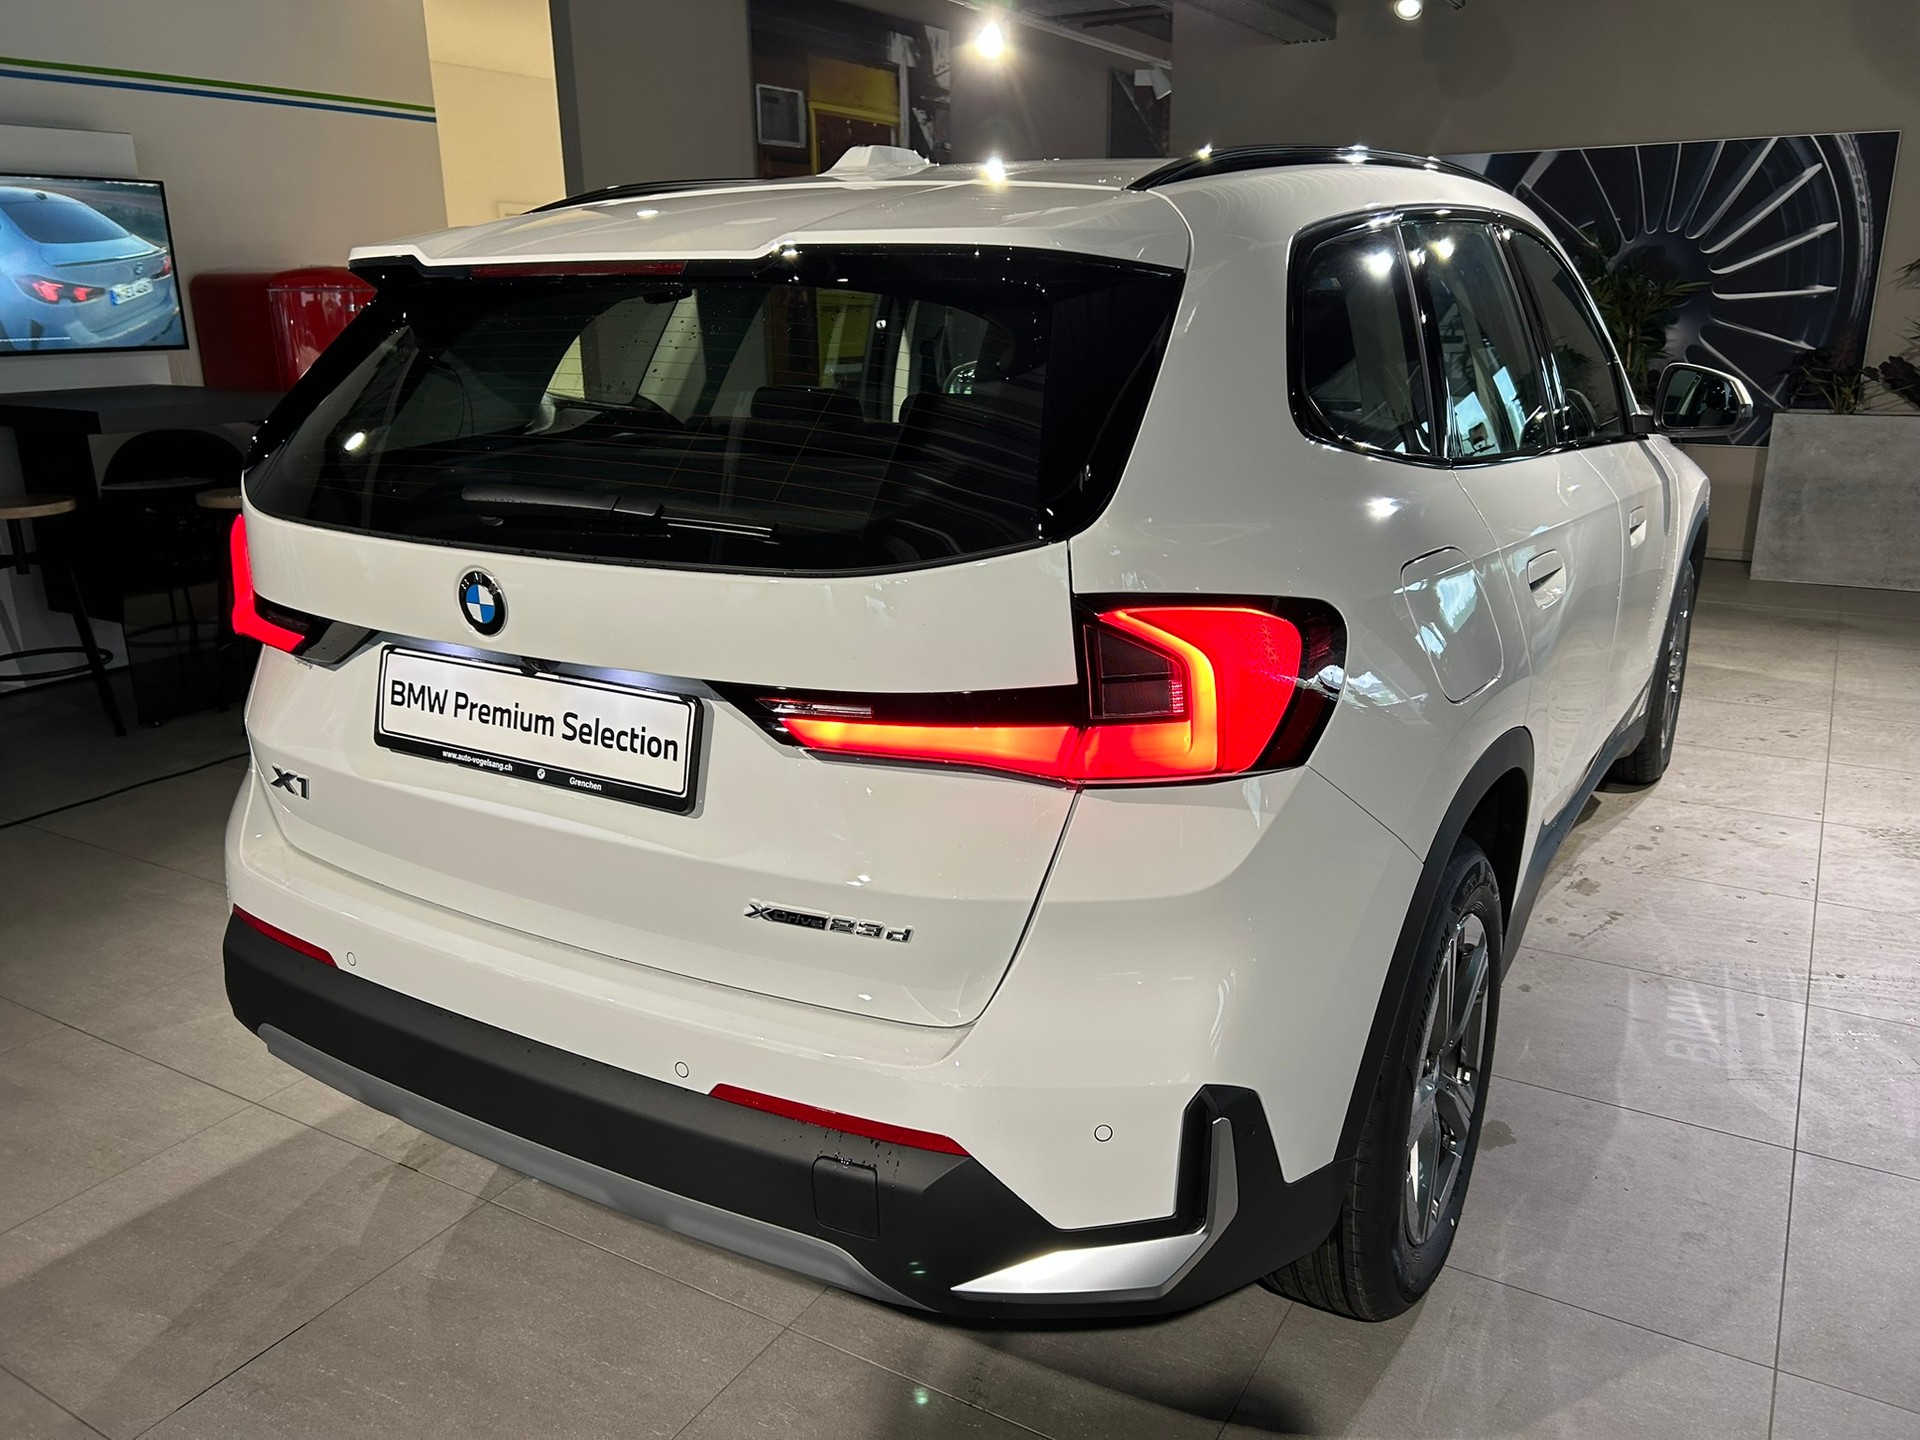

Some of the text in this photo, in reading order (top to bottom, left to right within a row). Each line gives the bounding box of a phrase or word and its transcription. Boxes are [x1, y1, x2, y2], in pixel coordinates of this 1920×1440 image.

[390, 679, 678, 762] BMW Premium Selection
[442, 750, 513, 772] www.auto-vogelsang.ch
[270, 764, 310, 800] X1
[569, 776, 602, 791] Grenchen
